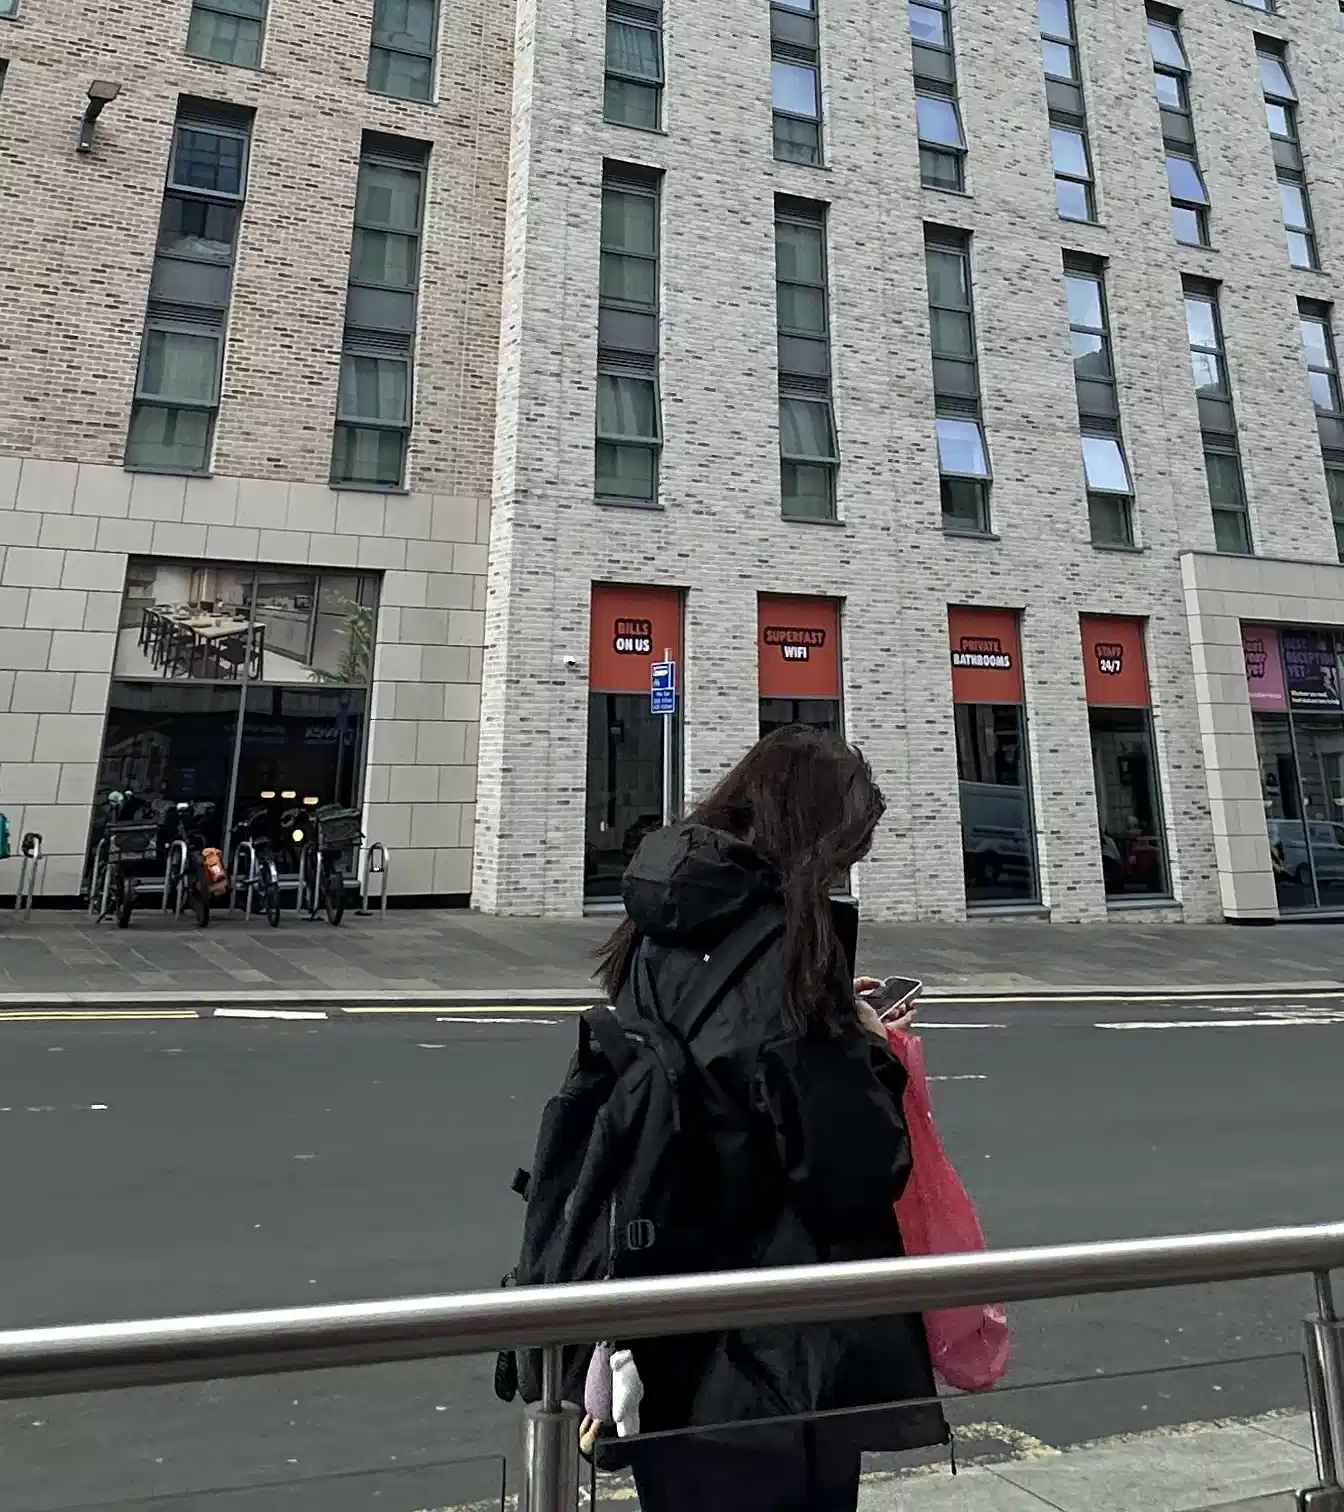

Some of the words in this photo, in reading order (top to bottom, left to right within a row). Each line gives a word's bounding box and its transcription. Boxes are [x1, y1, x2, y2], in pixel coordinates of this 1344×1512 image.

[617, 622, 649, 636] BILLS
[766, 630, 823, 645] SUPERFAST
[616, 638, 634, 651] ON
[635, 639, 650, 652] US
[962, 639, 1000, 652] PRIVATE
[1096, 645, 1122, 657] STAFF
[953, 653, 1011, 668] BATHROOMS
[1100, 659, 1121, 672] 24/7
